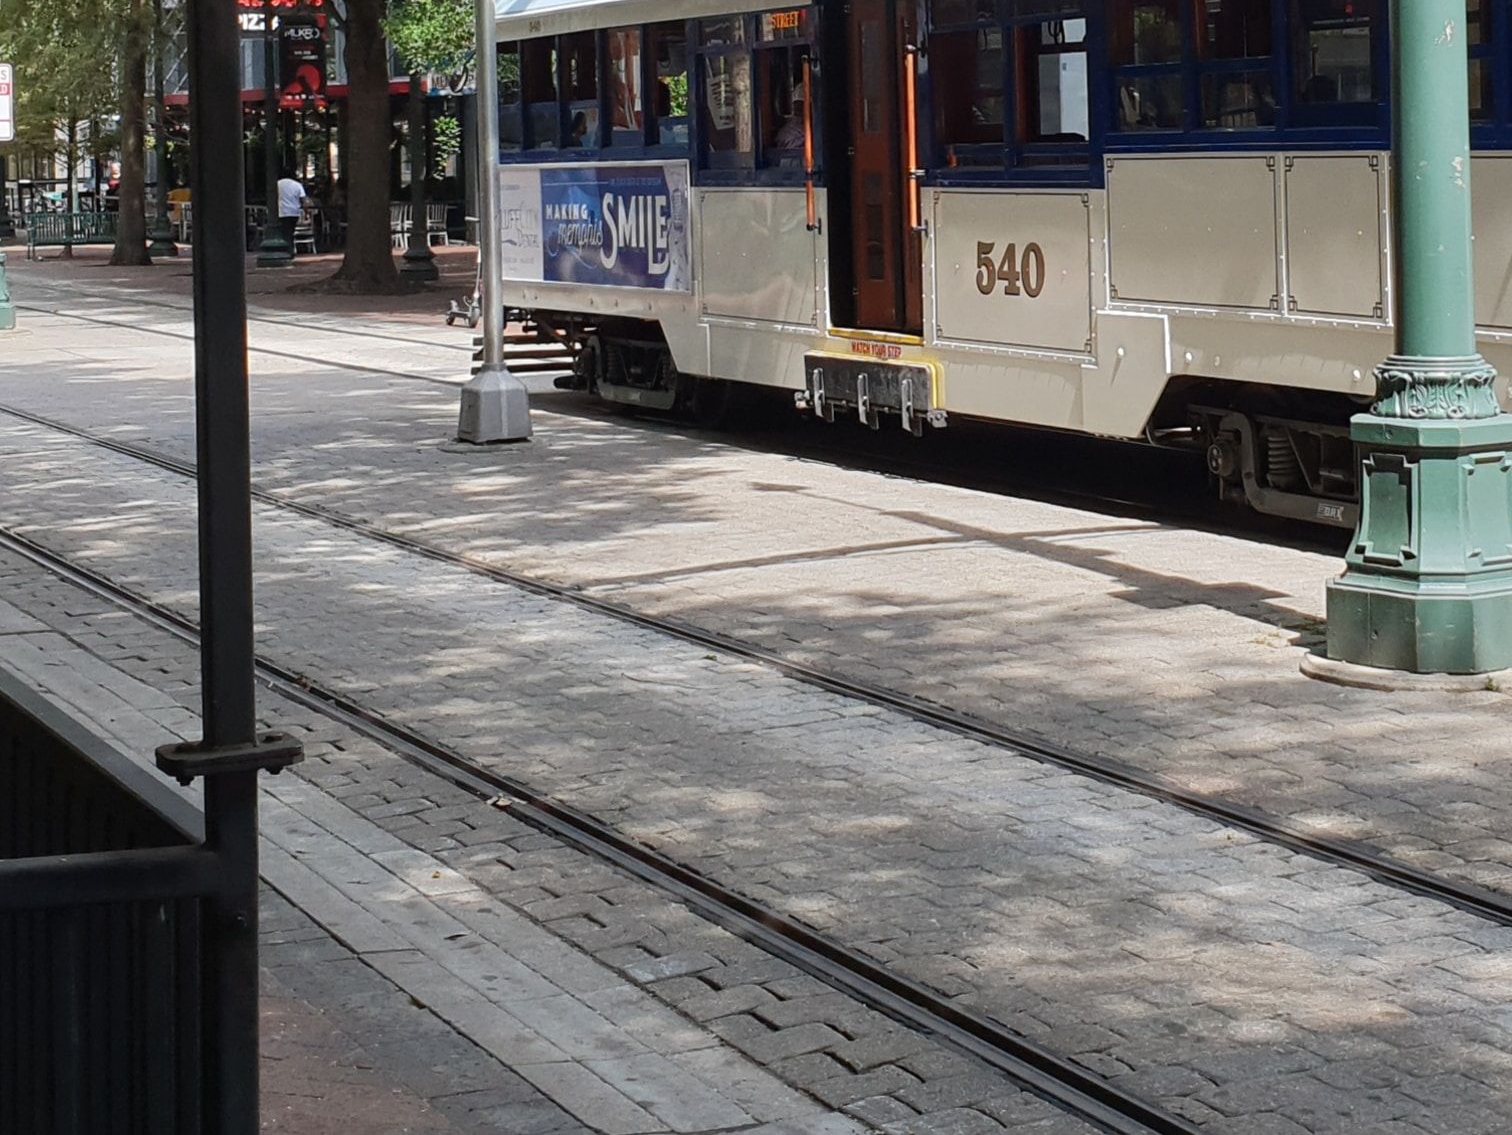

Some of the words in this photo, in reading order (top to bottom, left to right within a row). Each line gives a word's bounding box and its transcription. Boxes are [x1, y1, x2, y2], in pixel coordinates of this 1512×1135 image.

[545, 203, 588, 221] MAKING
[557, 217, 604, 252] memphis
[600, 192, 670, 275] SMILE
[976, 240, 1046, 298] 540
[887, 345, 903, 358] STEP
